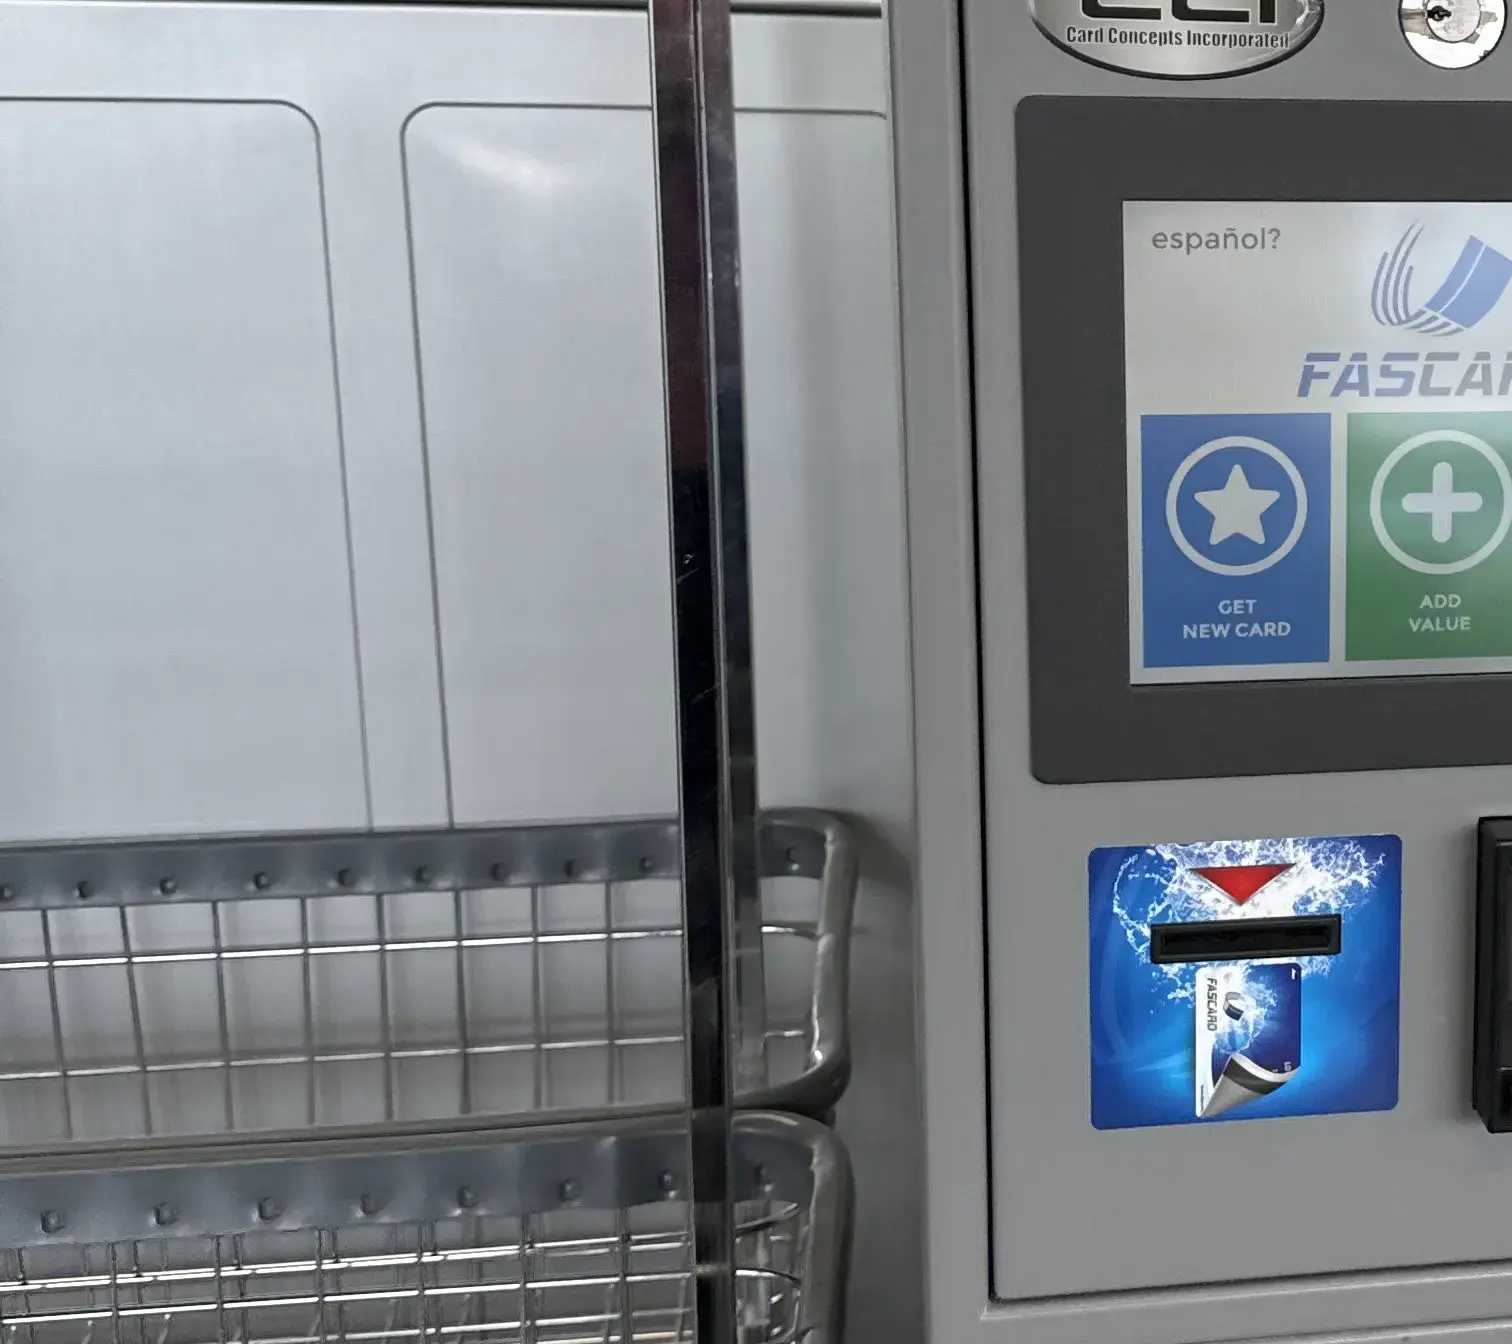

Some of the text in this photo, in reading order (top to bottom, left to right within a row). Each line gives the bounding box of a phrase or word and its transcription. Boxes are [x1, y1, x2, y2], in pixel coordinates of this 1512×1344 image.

[1066, 26, 1289, 48] Card Concepts Incorporated
[1151, 227, 1281, 256] español?
[1218, 599, 1257, 615] GET
[1419, 594, 1463, 609] ADD
[1182, 621, 1292, 639] NEW CARD
[1408, 616, 1472, 633] VALUE
[1206, 977, 1218, 1032] FASCARD
